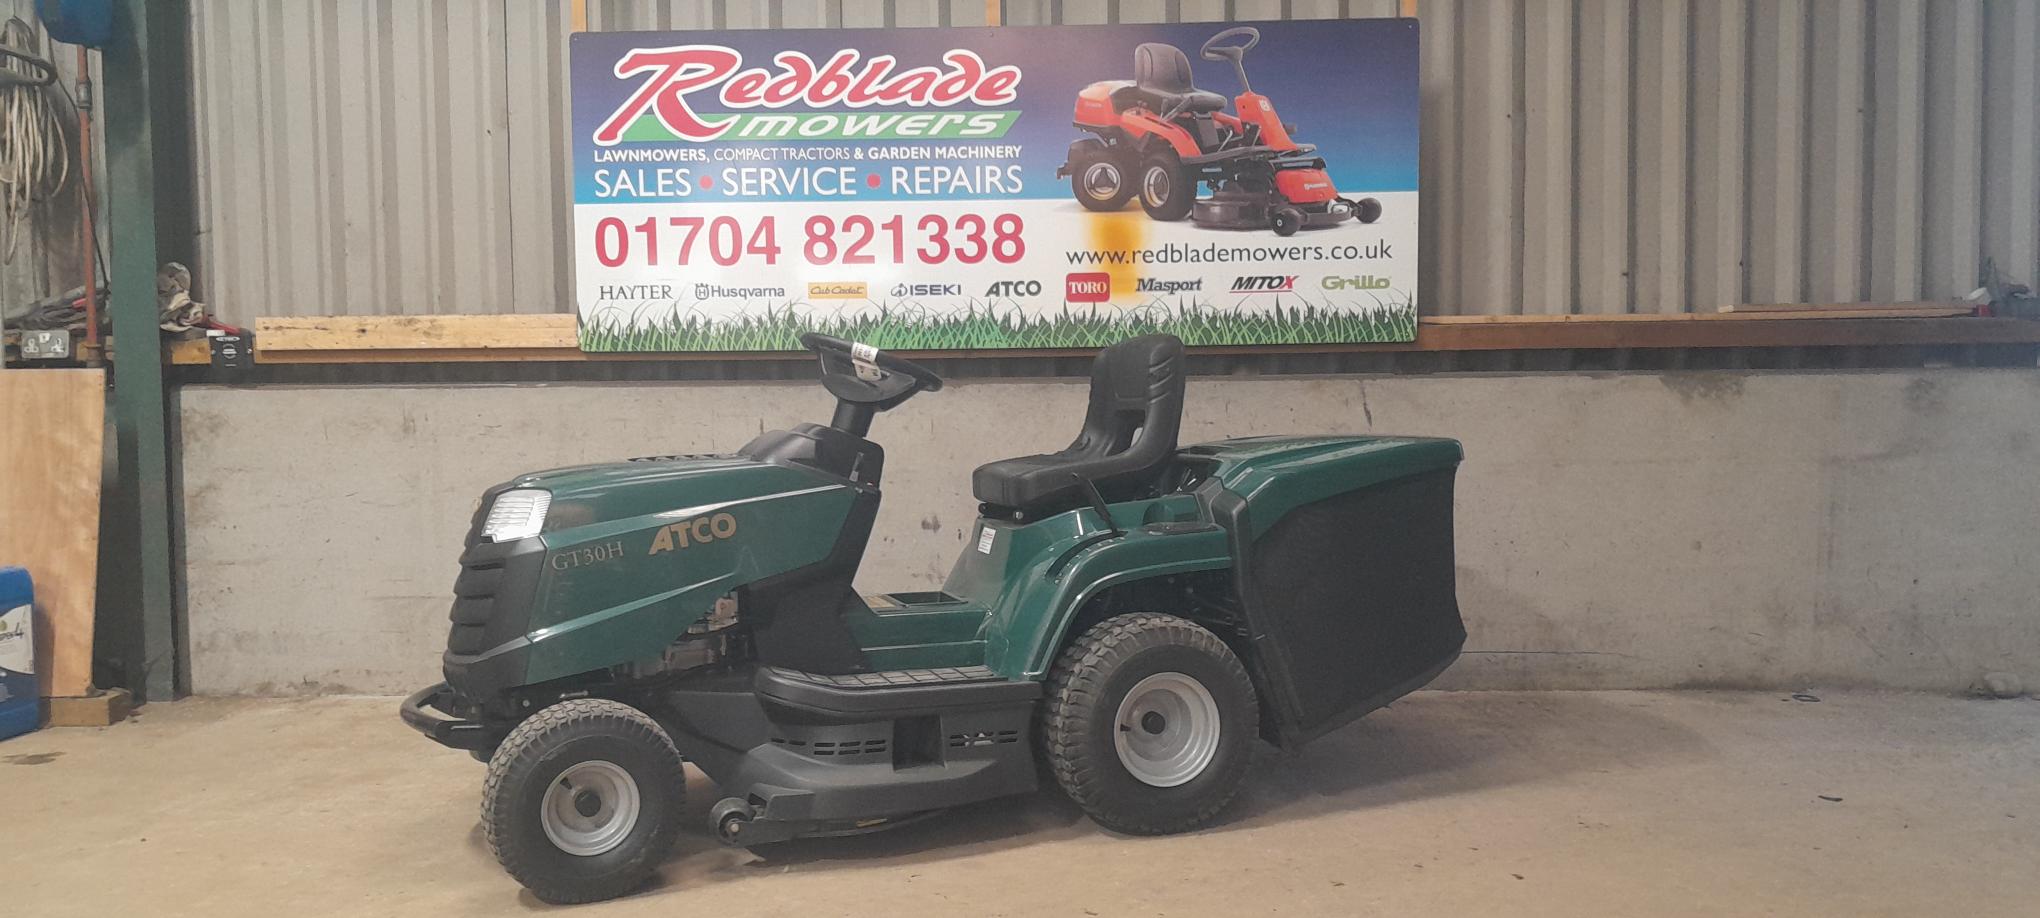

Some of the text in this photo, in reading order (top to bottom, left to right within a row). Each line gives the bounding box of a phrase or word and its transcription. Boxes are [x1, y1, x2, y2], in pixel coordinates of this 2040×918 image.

[593, 44, 1023, 146] Redblade
[738, 111, 1002, 138] mowers
[594, 145, 1022, 163] LAWNMOWERS, COMPACT TRACTORS & GARDEN MACHINERY
[594, 165, 1023, 197] SALES SERVICE REPAIRS
[595, 213, 1026, 267] 01704 821338
[1066, 239, 1393, 265] www.redblademowers.co.uk
[910, 284, 961, 296] ISEKI
[985, 280, 1042, 297] ATCO
[1068, 281, 1108, 294] TORO
[1136, 278, 1202, 293] Masport
[1230, 276, 1299, 290] MITOX
[1321, 276, 1392, 289] Grillo
[600, 285, 673, 300] HAYTER
[711, 285, 785, 298] Husqvarna
[648, 513, 737, 556] ATCO
[551, 540, 624, 571] GT30H
